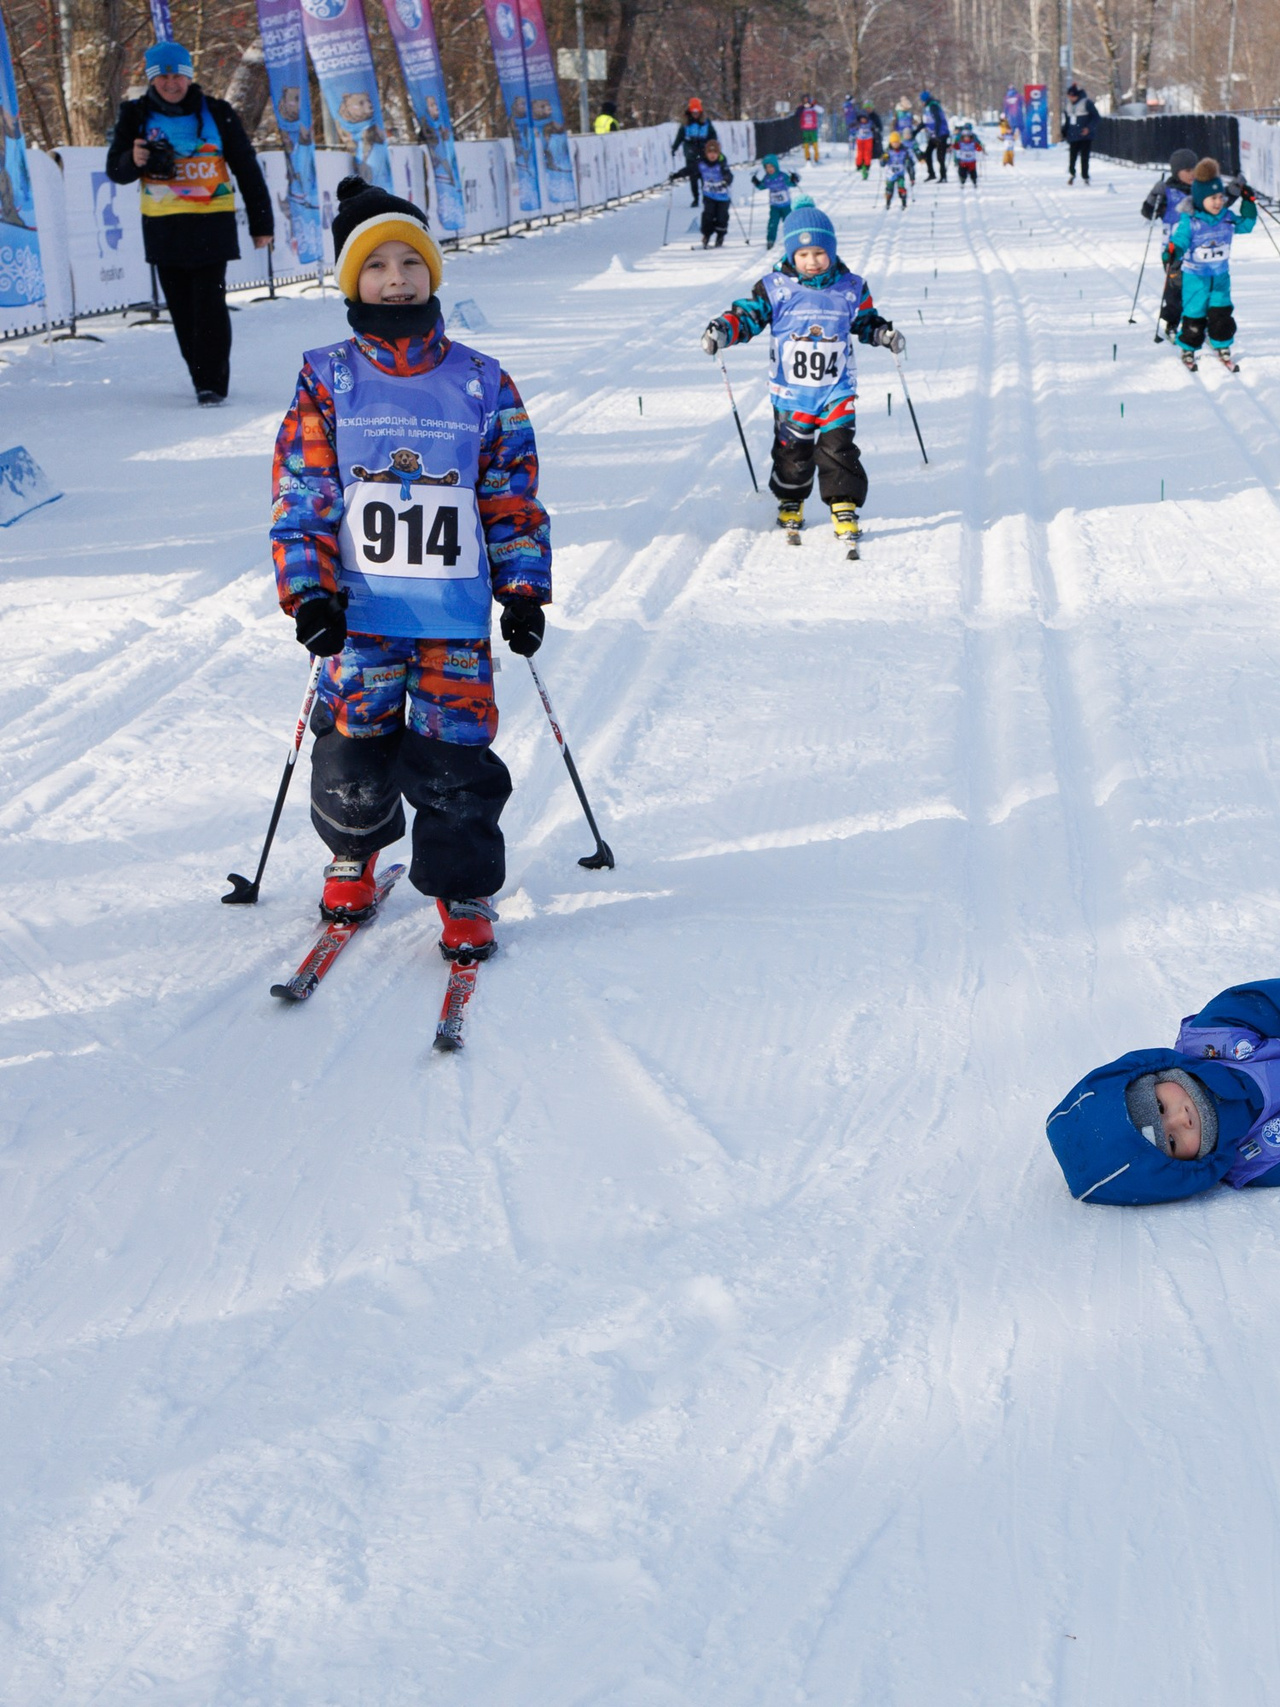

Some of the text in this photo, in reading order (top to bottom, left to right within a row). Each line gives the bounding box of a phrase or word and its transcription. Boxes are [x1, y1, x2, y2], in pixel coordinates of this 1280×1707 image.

[1030, 89, 1043, 148] СТАРТ
[793, 350, 839, 381] 894
[363, 426, 455, 441] ЛЫЖНЫЙ МАРАФОН
[362, 501, 462, 567] 914
